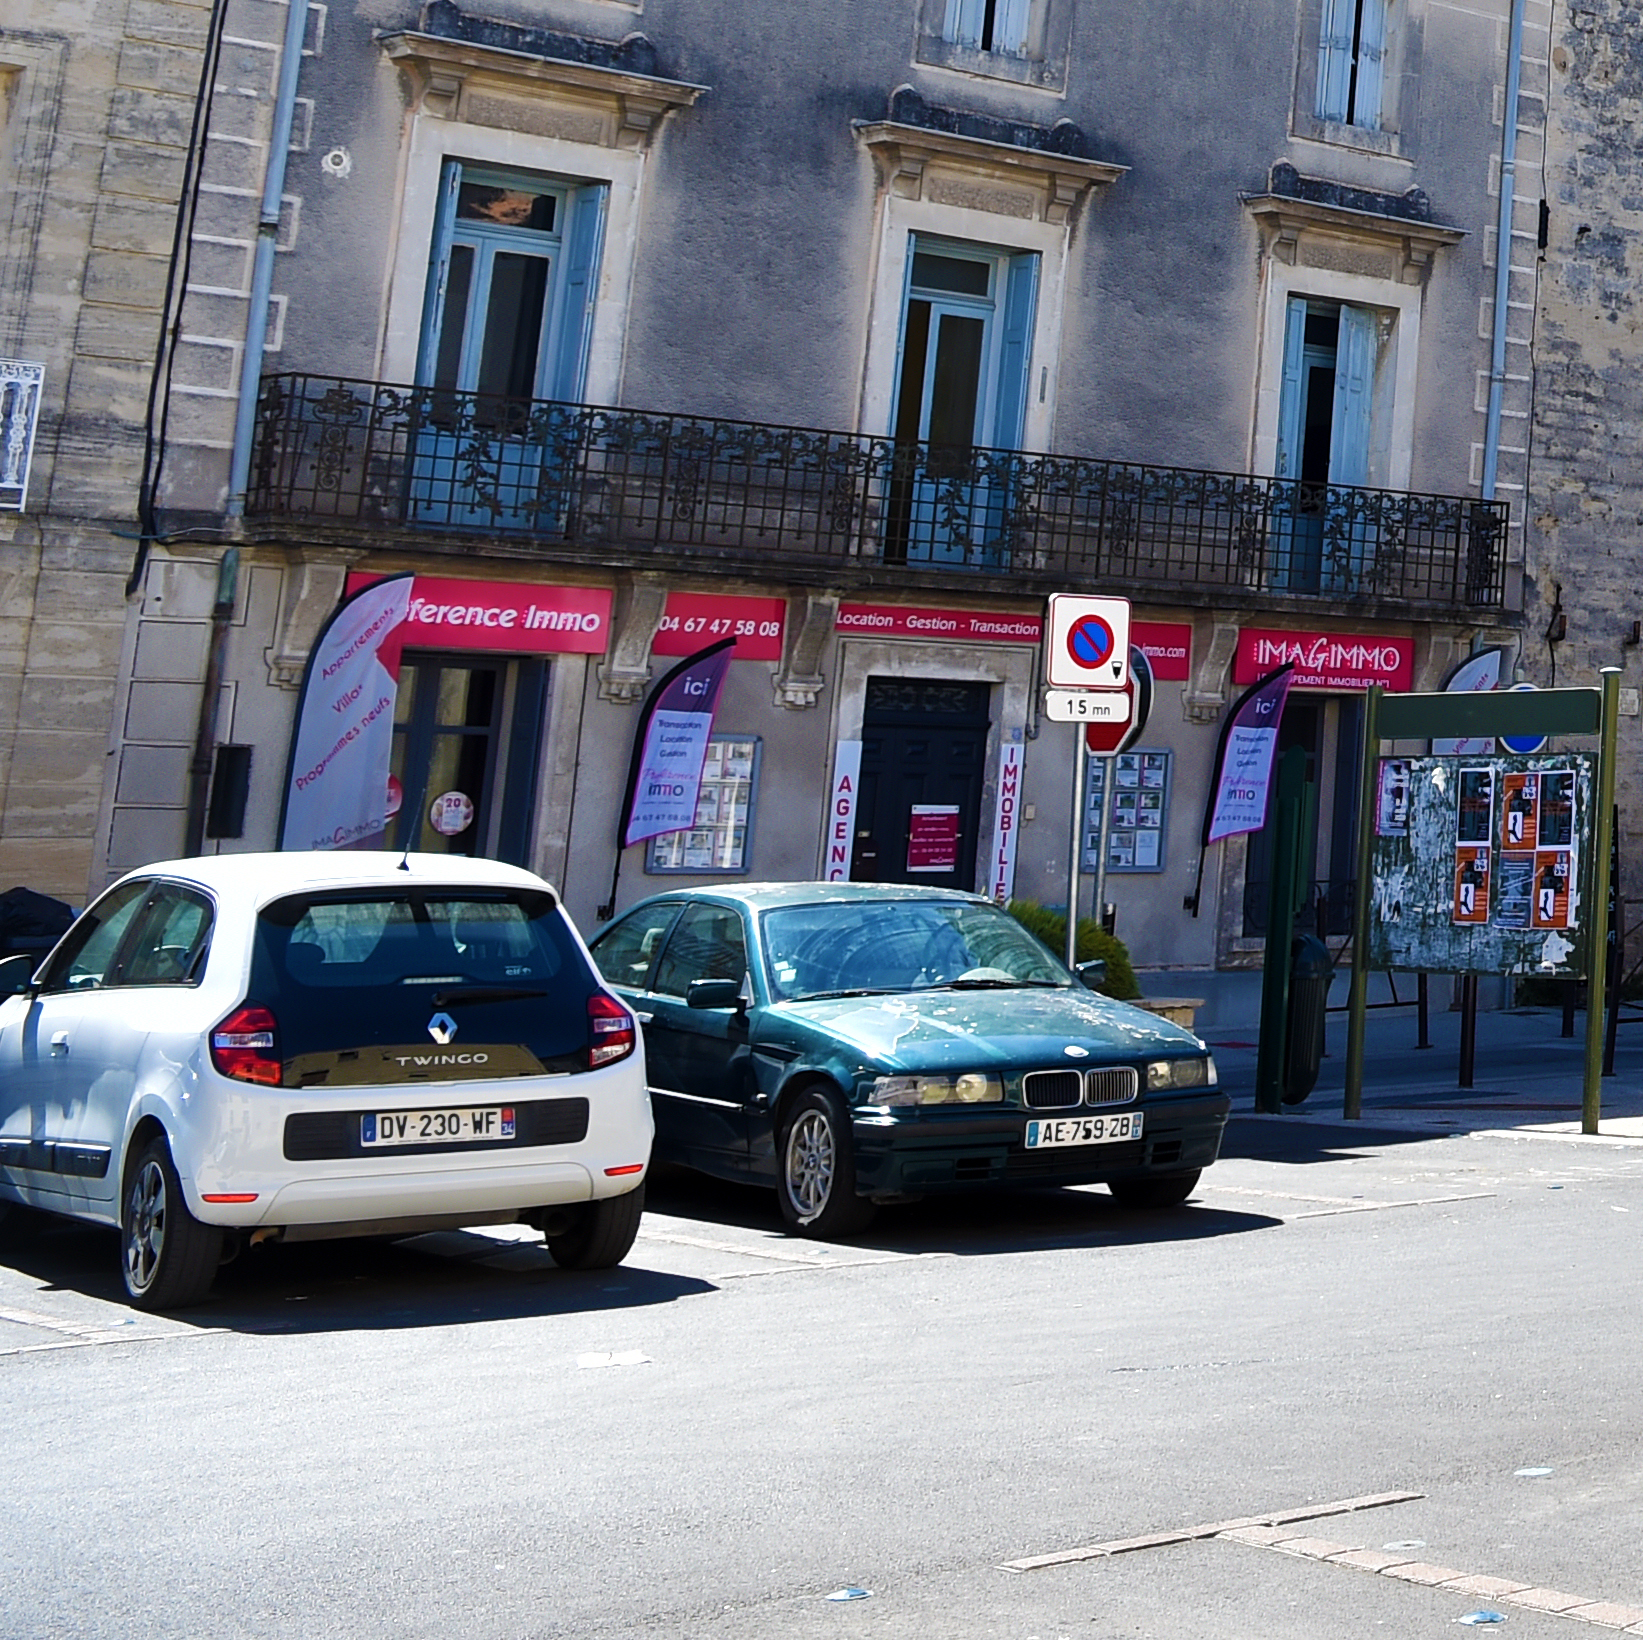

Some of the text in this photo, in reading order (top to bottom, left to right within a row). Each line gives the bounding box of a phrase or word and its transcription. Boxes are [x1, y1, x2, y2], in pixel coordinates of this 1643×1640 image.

[525, 604, 600, 633] Immo
[659, 615, 780, 637] 04 67 47 58 08
[836, 611, 1039, 636] Location Gestion Transaction
[322, 606, 395, 680] Appartements
[1257, 637, 1400, 673] IMAGIMMO
[683, 677, 710, 696] ici
[361, 697, 390, 728] neufs
[1067, 699, 1111, 715] 15 mn
[445, 797, 461, 808] 20
[395, 1052, 489, 1067] TWINGO
[380, 1111, 498, 1140] DV-230-WF
[502, 1123, 513, 1135] 34
[1042, 1116, 1130, 1143] AE-759-ZB
